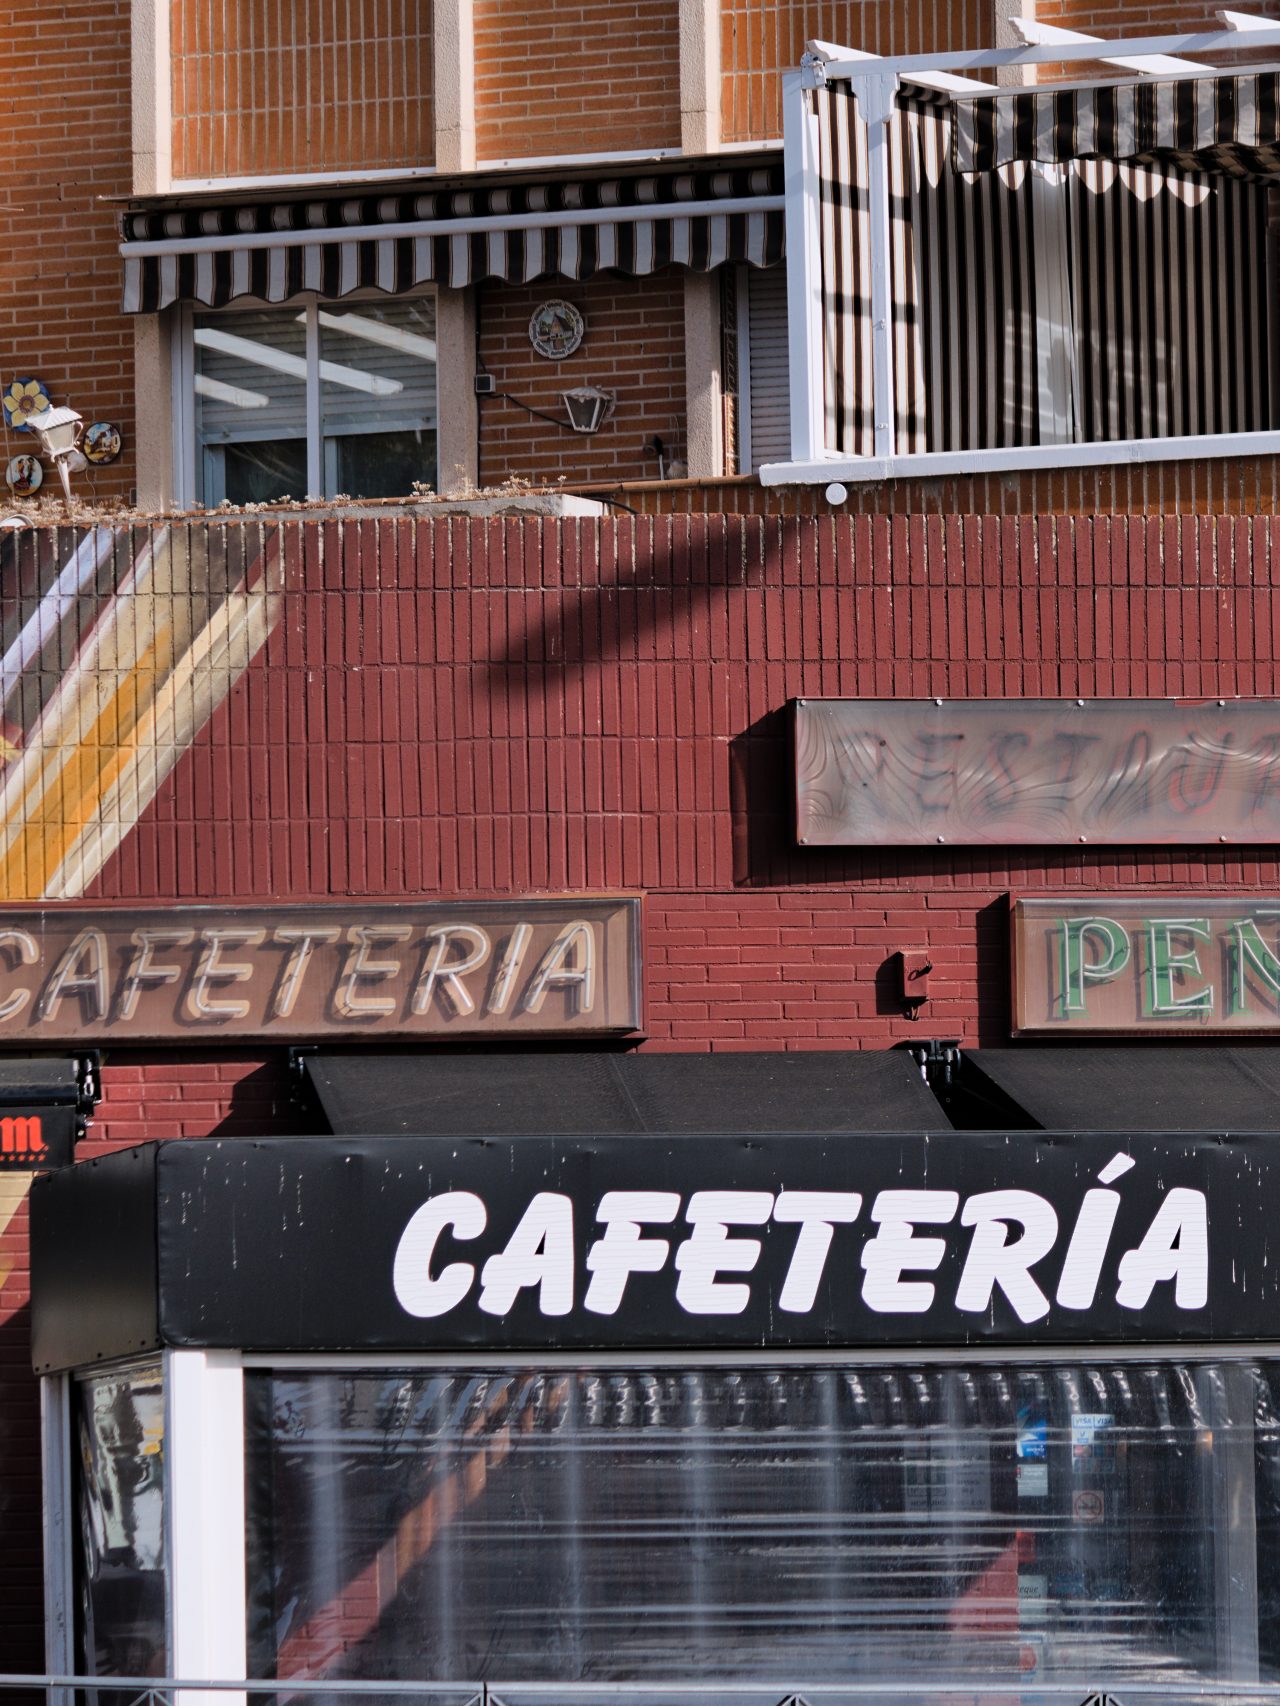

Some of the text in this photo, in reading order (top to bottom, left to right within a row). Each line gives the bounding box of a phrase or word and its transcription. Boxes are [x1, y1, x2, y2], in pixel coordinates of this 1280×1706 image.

[0, 918, 596, 1022] CAFETERIA
[393, 1152, 1210, 1325] CAFETERÍA
[1096, 1417, 1114, 1425] VISA
